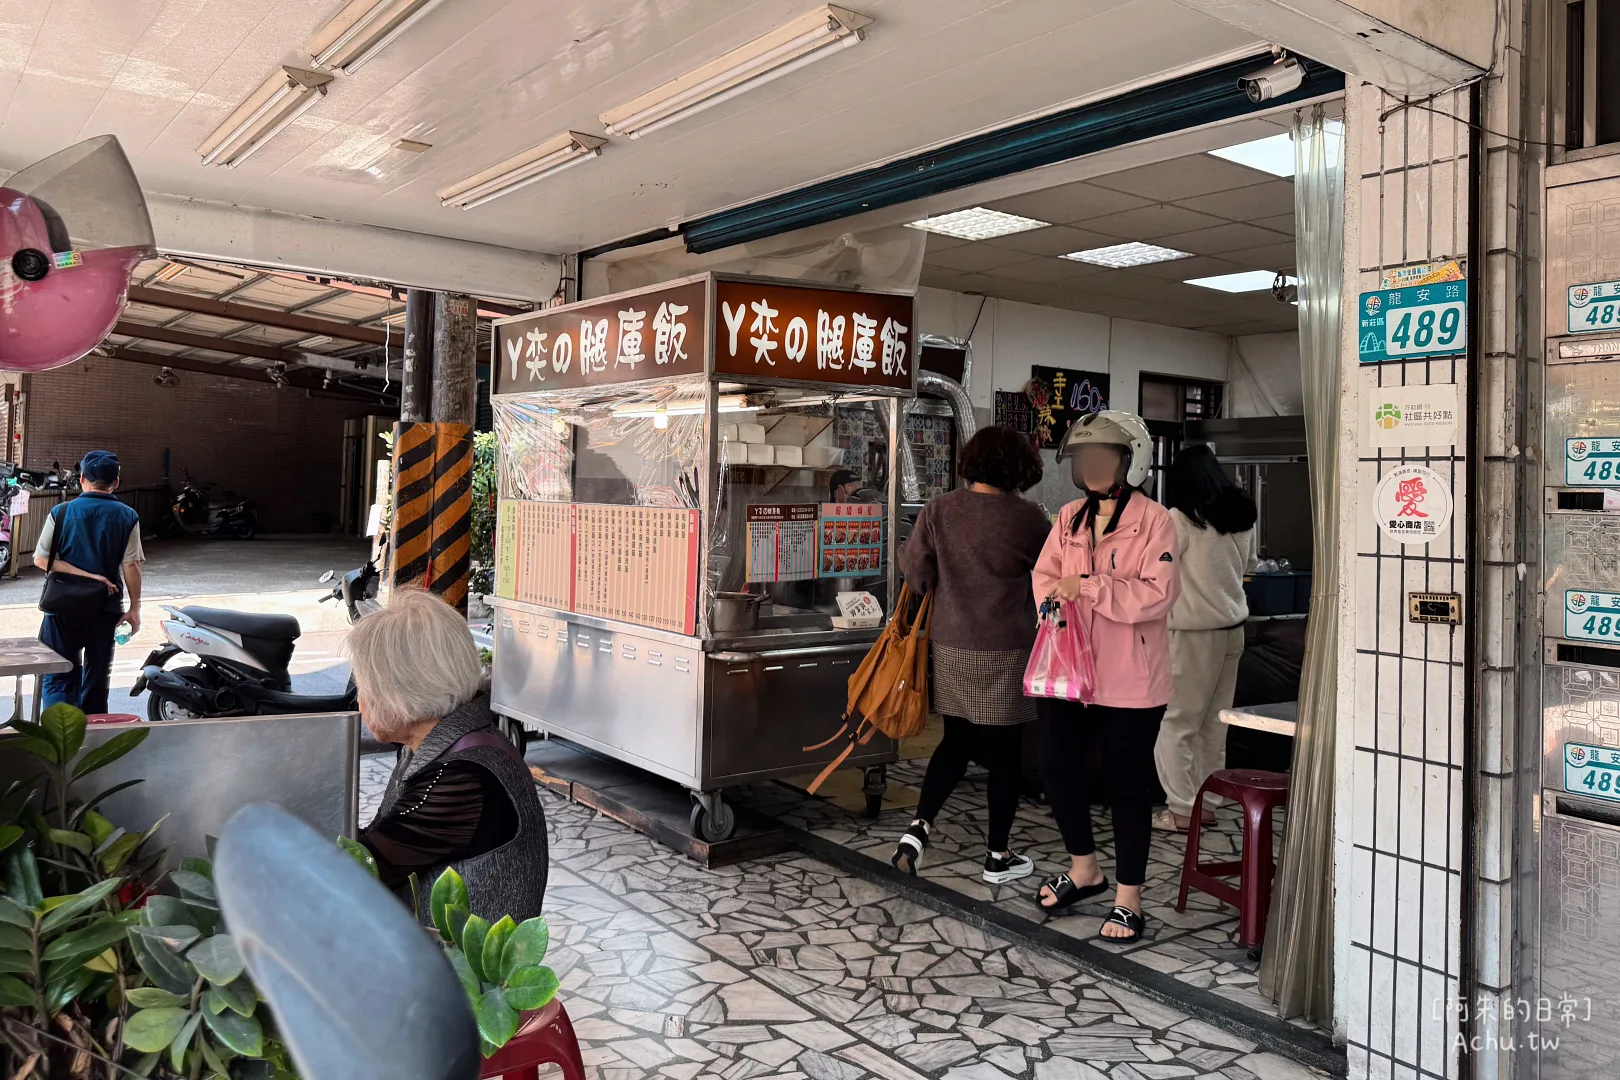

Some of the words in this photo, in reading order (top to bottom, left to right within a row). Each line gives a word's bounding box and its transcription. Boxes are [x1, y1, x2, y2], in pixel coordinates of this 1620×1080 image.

[1388, 285, 1460, 305] 龍安路
[1585, 304, 1620, 326] 48
[1391, 307, 1460, 349] 489
[1404, 410, 1453, 421] 社區共好點
[1388, 520, 1422, 529] 愛心商店
